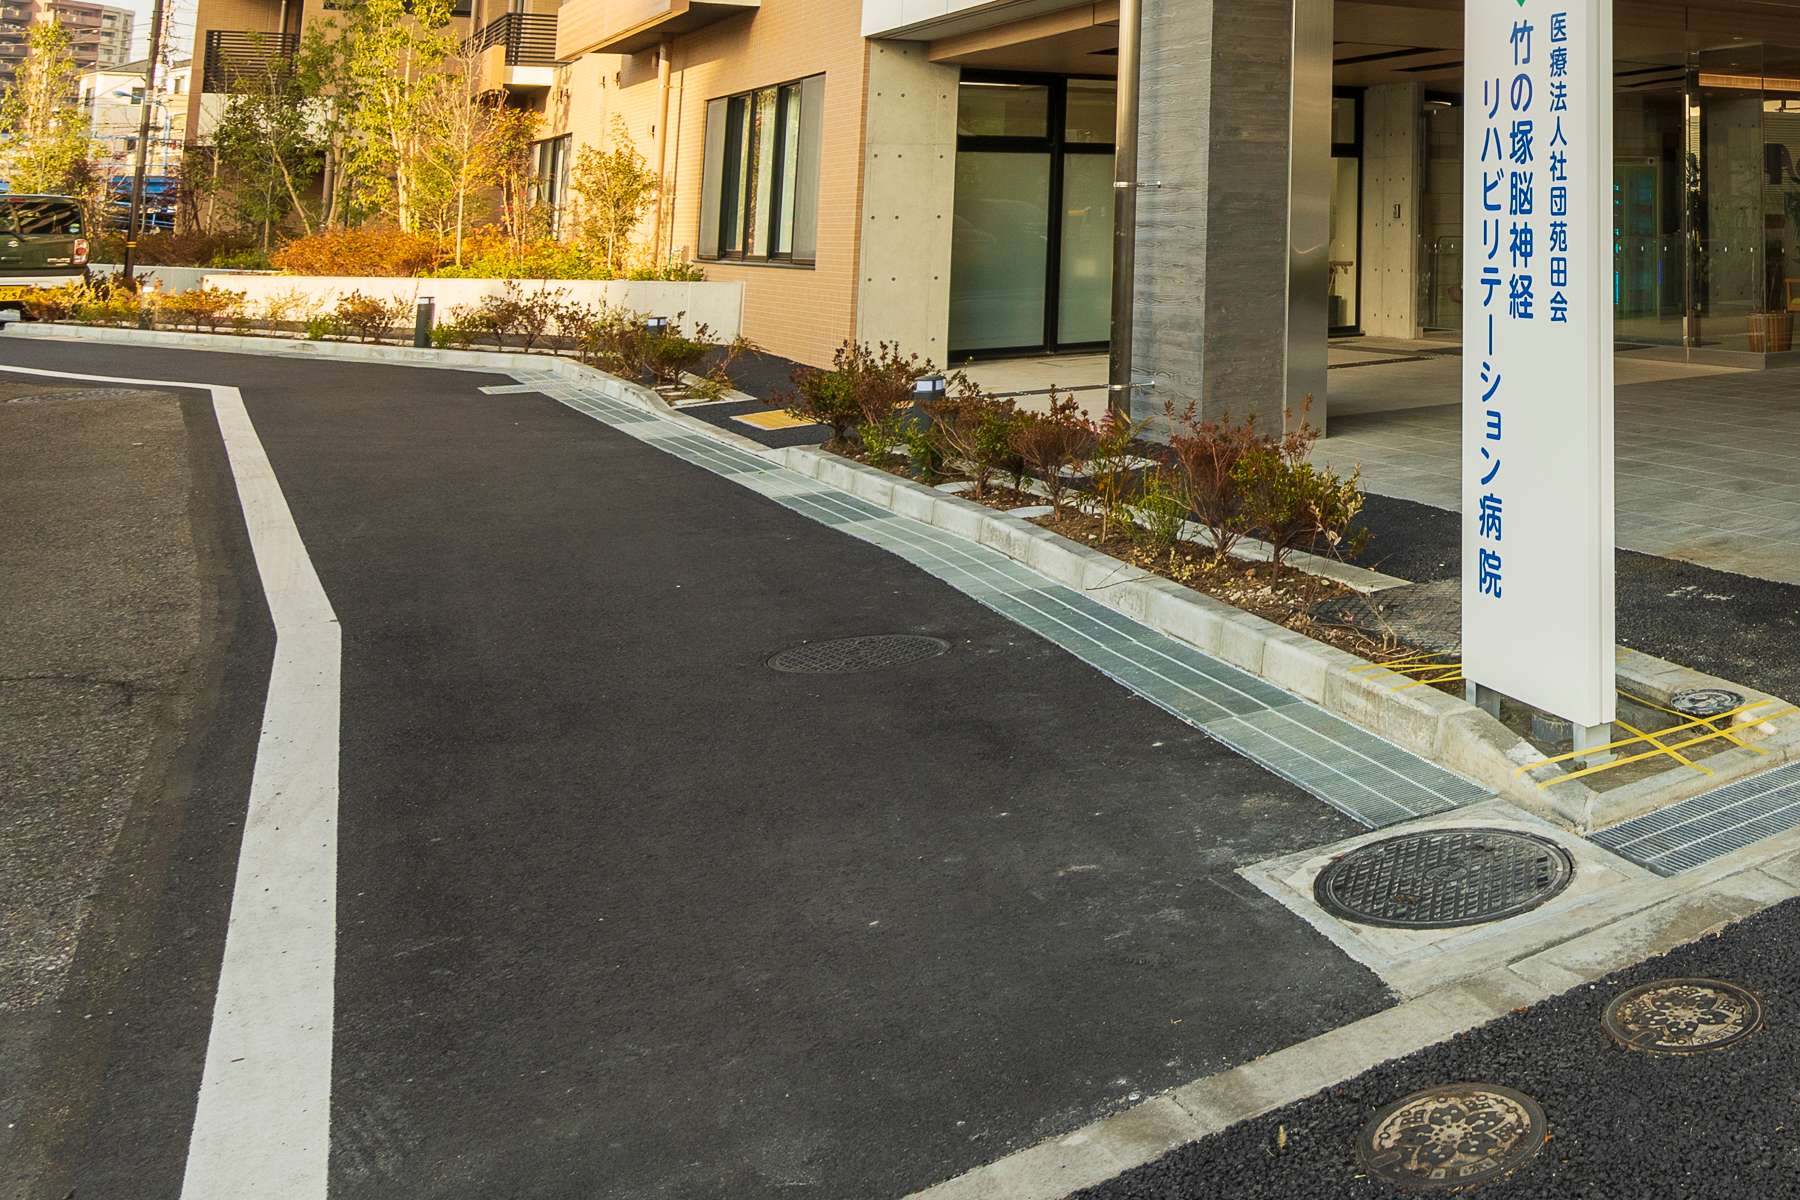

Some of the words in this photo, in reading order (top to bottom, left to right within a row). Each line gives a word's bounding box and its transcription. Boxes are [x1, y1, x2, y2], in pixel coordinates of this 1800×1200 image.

[1508, 19, 1535, 321] 竹の塚脳神経
[1549, 11, 1569, 323] 医療法人社団苑田会
[1478, 77, 1504, 600] リハビリテーション病院
